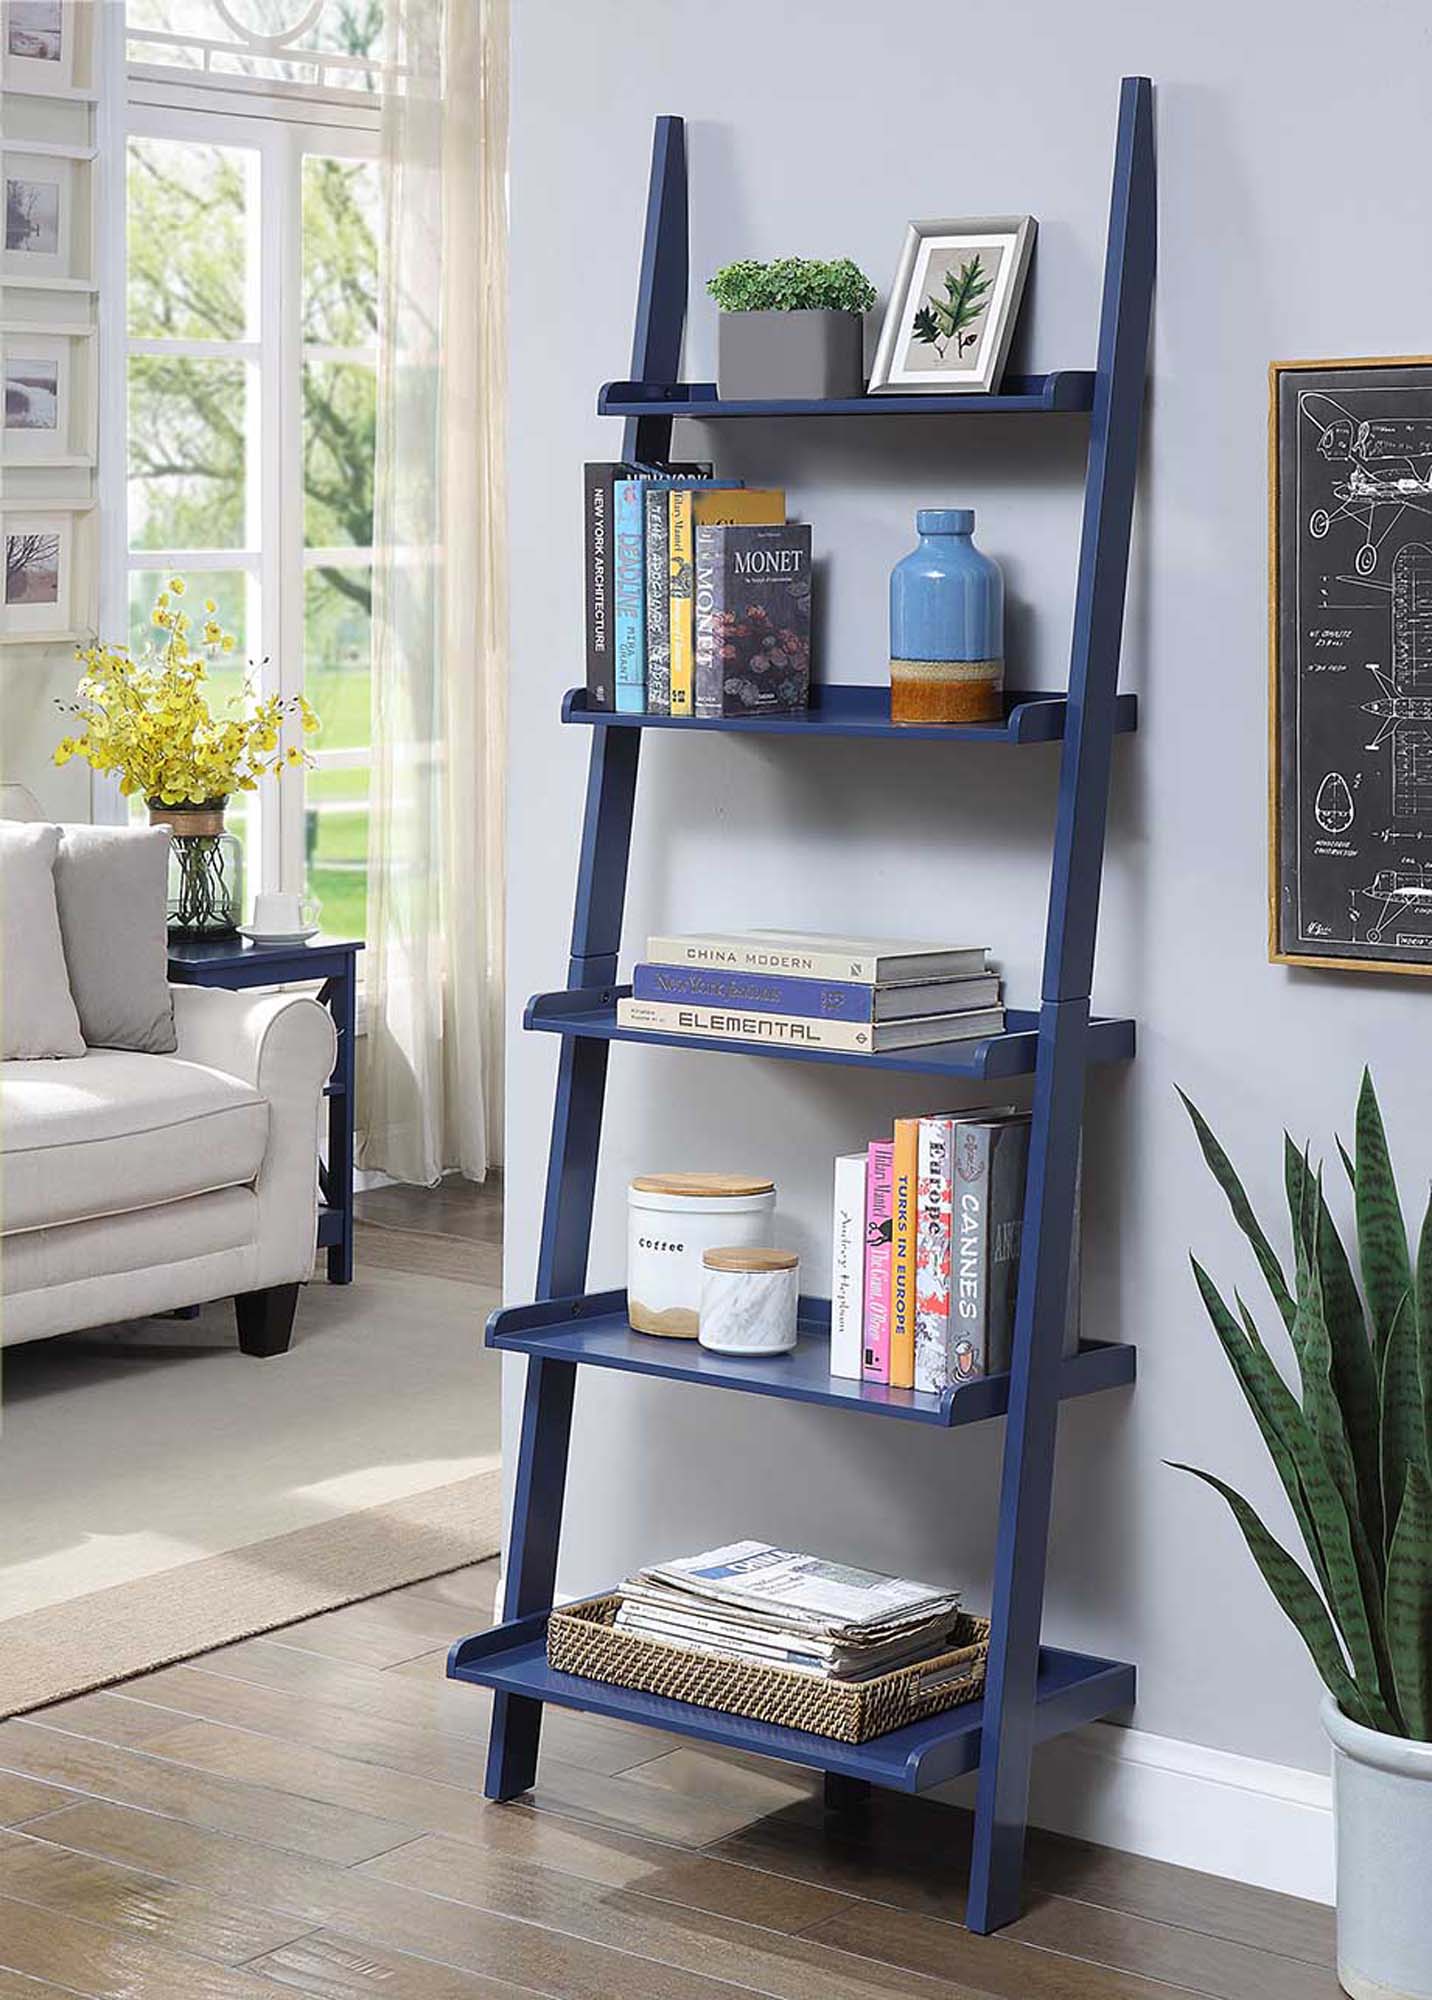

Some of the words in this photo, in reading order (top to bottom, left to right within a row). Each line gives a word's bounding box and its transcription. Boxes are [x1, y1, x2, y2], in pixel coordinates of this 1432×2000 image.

[594, 488, 604, 518] NEW
[594, 520, 605, 555] YORK
[618, 532, 641, 619] DEADLINE
[734, 550, 803, 574] MONET
[594, 557, 605, 652] ARCHITECTURE
[696, 568, 714, 668] MONET
[627, 626, 636, 656] MIRA
[619, 643, 629, 681] GRANT
[687, 948, 737, 963] CHINA
[746, 954, 813, 969] MODERN
[872, 1184, 891, 1218] Mantel
[898, 1176, 908, 1232] TURKS
[925, 1141, 946, 1235] Europe
[897, 1238, 907, 1258] IN
[959, 1194, 980, 1319] CANNES
[895, 1265, 906, 1334] EUROPE
